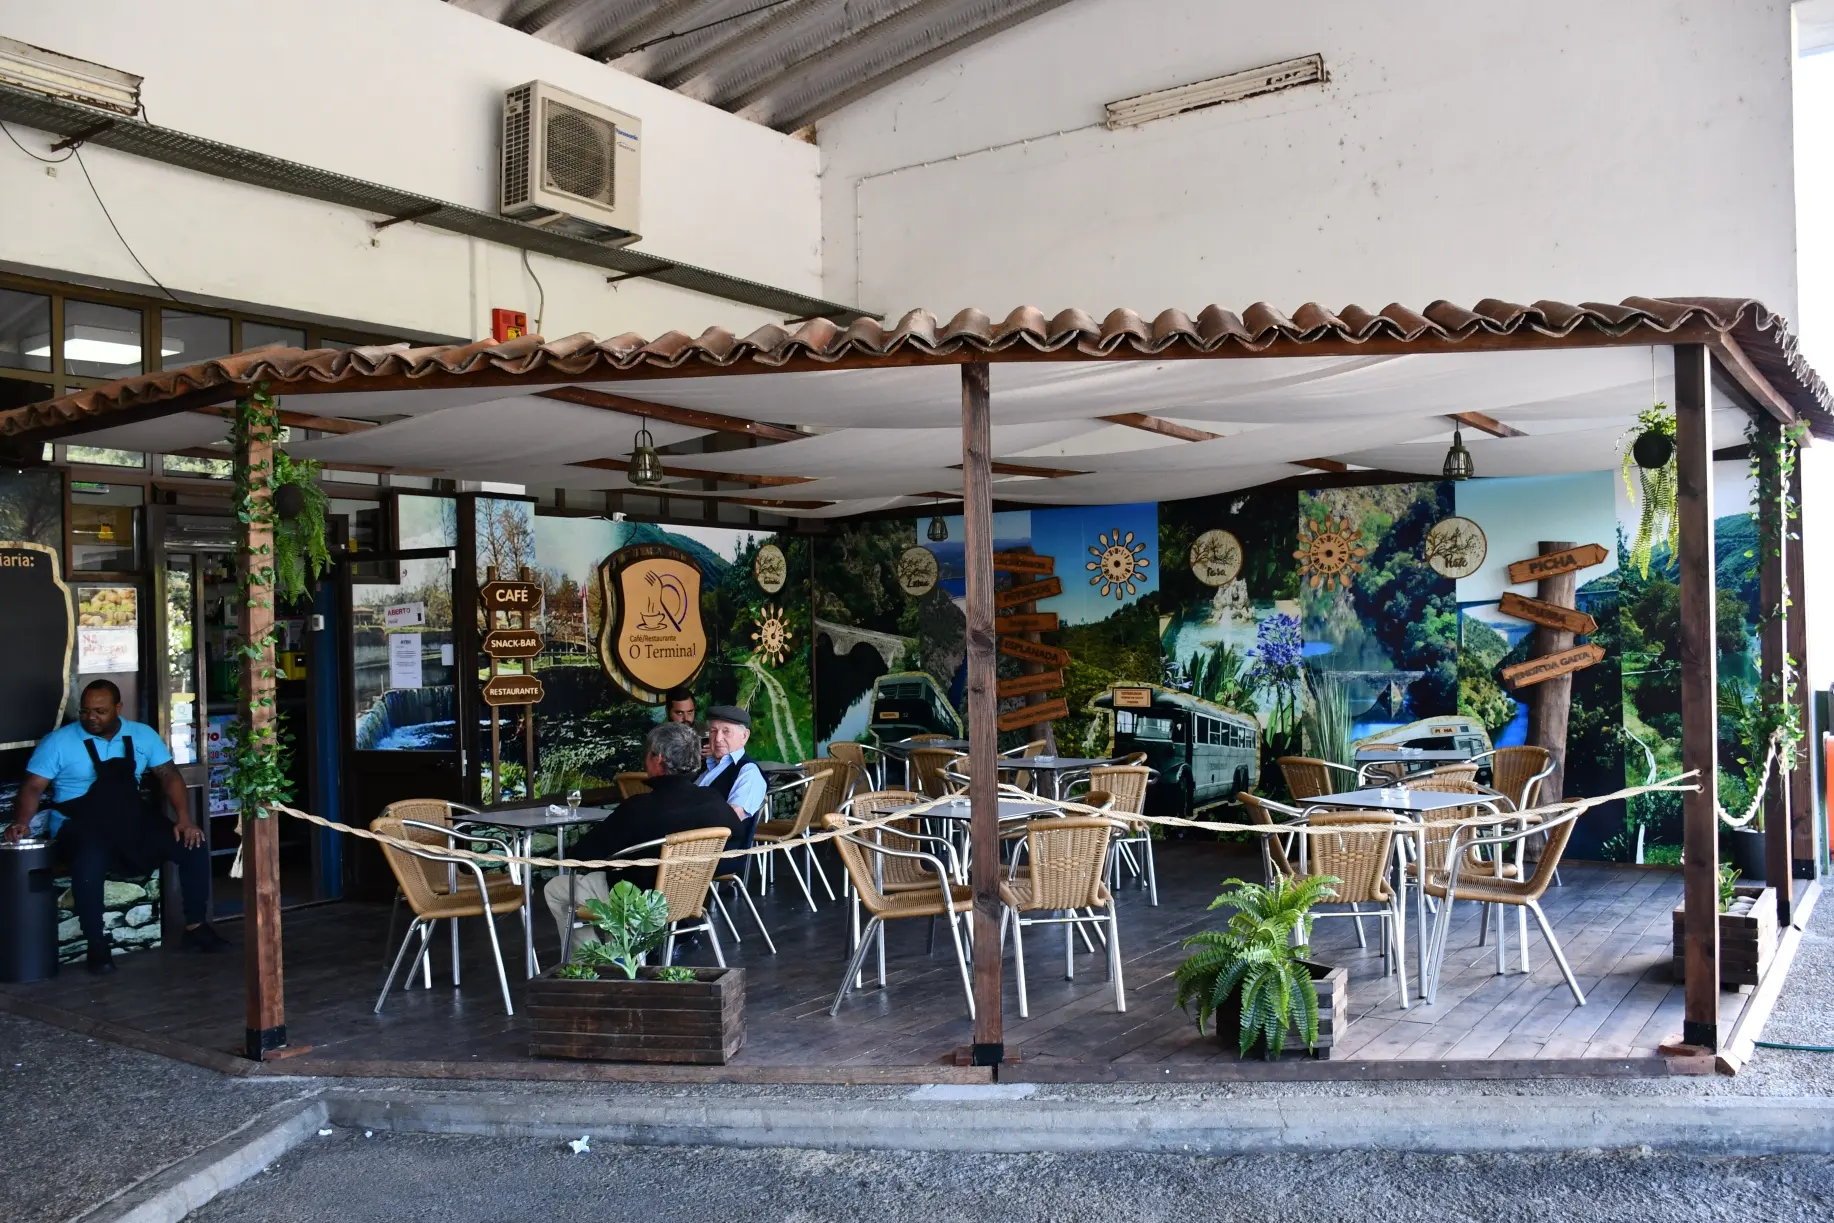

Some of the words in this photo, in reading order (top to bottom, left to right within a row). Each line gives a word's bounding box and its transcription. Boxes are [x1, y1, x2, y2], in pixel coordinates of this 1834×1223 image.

[1528, 554, 1578, 574] PICHA
[495, 585, 529, 602] CAFÉ
[387, 607, 411, 617] ABERTO
[490, 638, 536, 648] SNACK-BAR
[629, 644, 641, 659] O
[644, 642, 697, 659] Terminal
[1004, 640, 1059, 663] ESPLANADA
[1560, 651, 1591, 666] GAITA
[489, 686, 539, 696] RESTAURANTE
